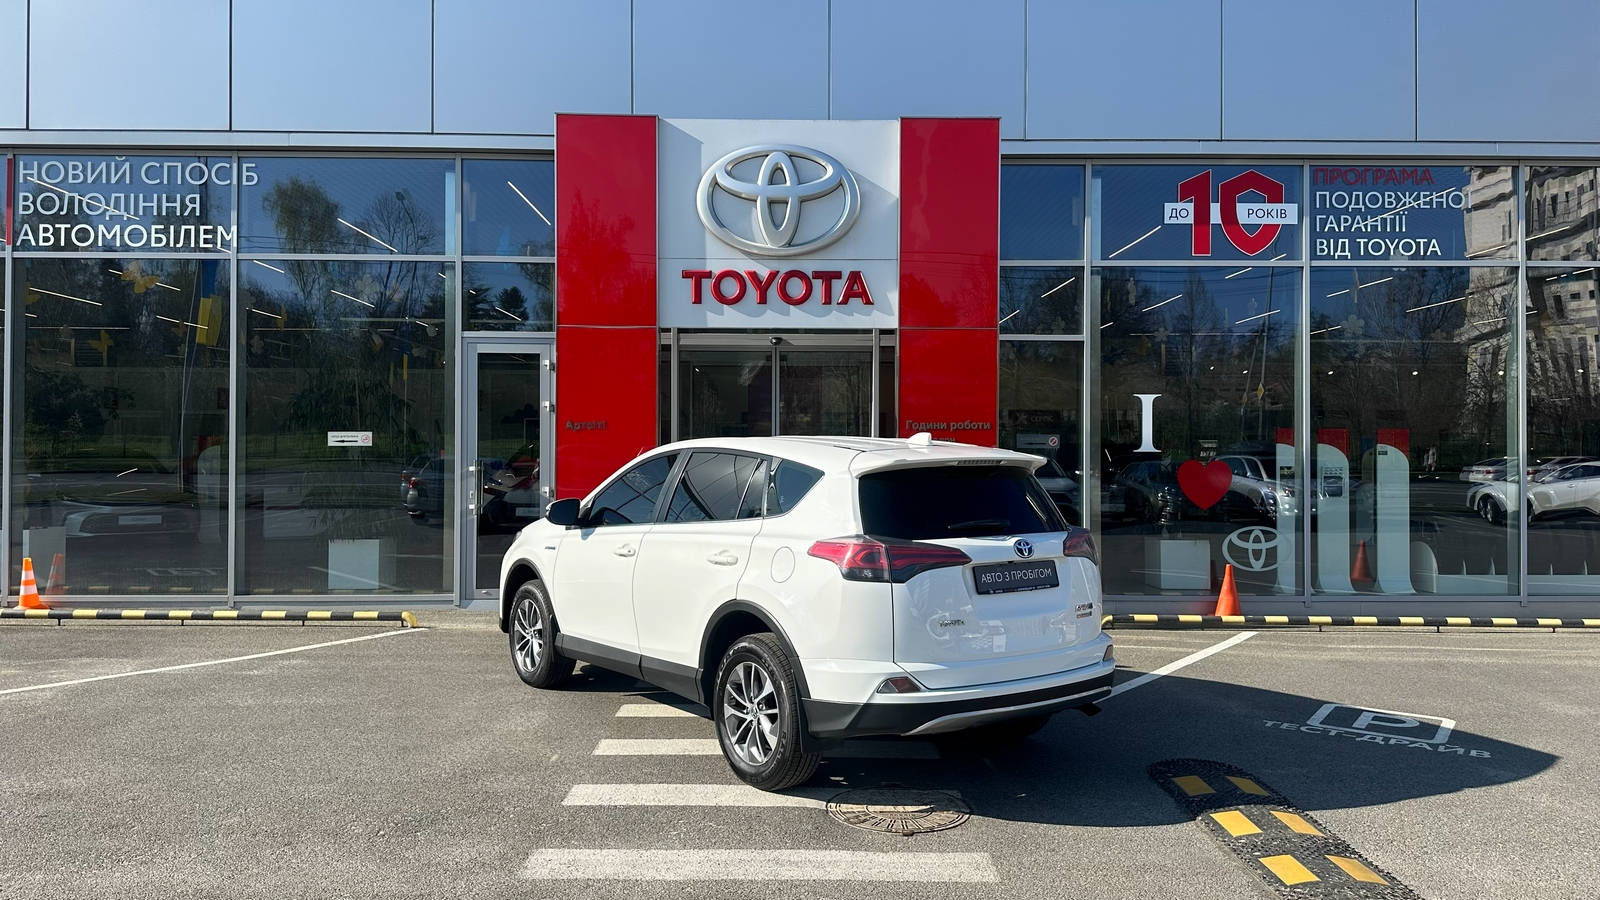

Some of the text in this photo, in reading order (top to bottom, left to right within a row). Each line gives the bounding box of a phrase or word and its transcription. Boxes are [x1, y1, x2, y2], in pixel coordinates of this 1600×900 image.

[19, 155, 259, 186] НОВИЙ СПОСІБ
[1314, 168, 1435, 185] ПРОГРАМА
[18, 193, 200, 220] ВОЛОДІННЯ
[1315, 187, 1472, 212] ПОДОВЖЕНОЇ
[1169, 169, 1288, 256] ДО 10 РОКІВ
[1315, 211, 1409, 232] ГАРАНТІЇ
[16, 223, 238, 248] АВТОМОБІЛЕМ
[1316, 238, 1442, 259] ВІД TOYOTA
[681, 269, 875, 306] TOYOTA
[905, 420, 991, 431] Години роботи
[981, 568, 1052, 584] АВТО З ПРОБІГОМ
[1263, 719, 1492, 759] ТЕСТ-ДРАЙВ
